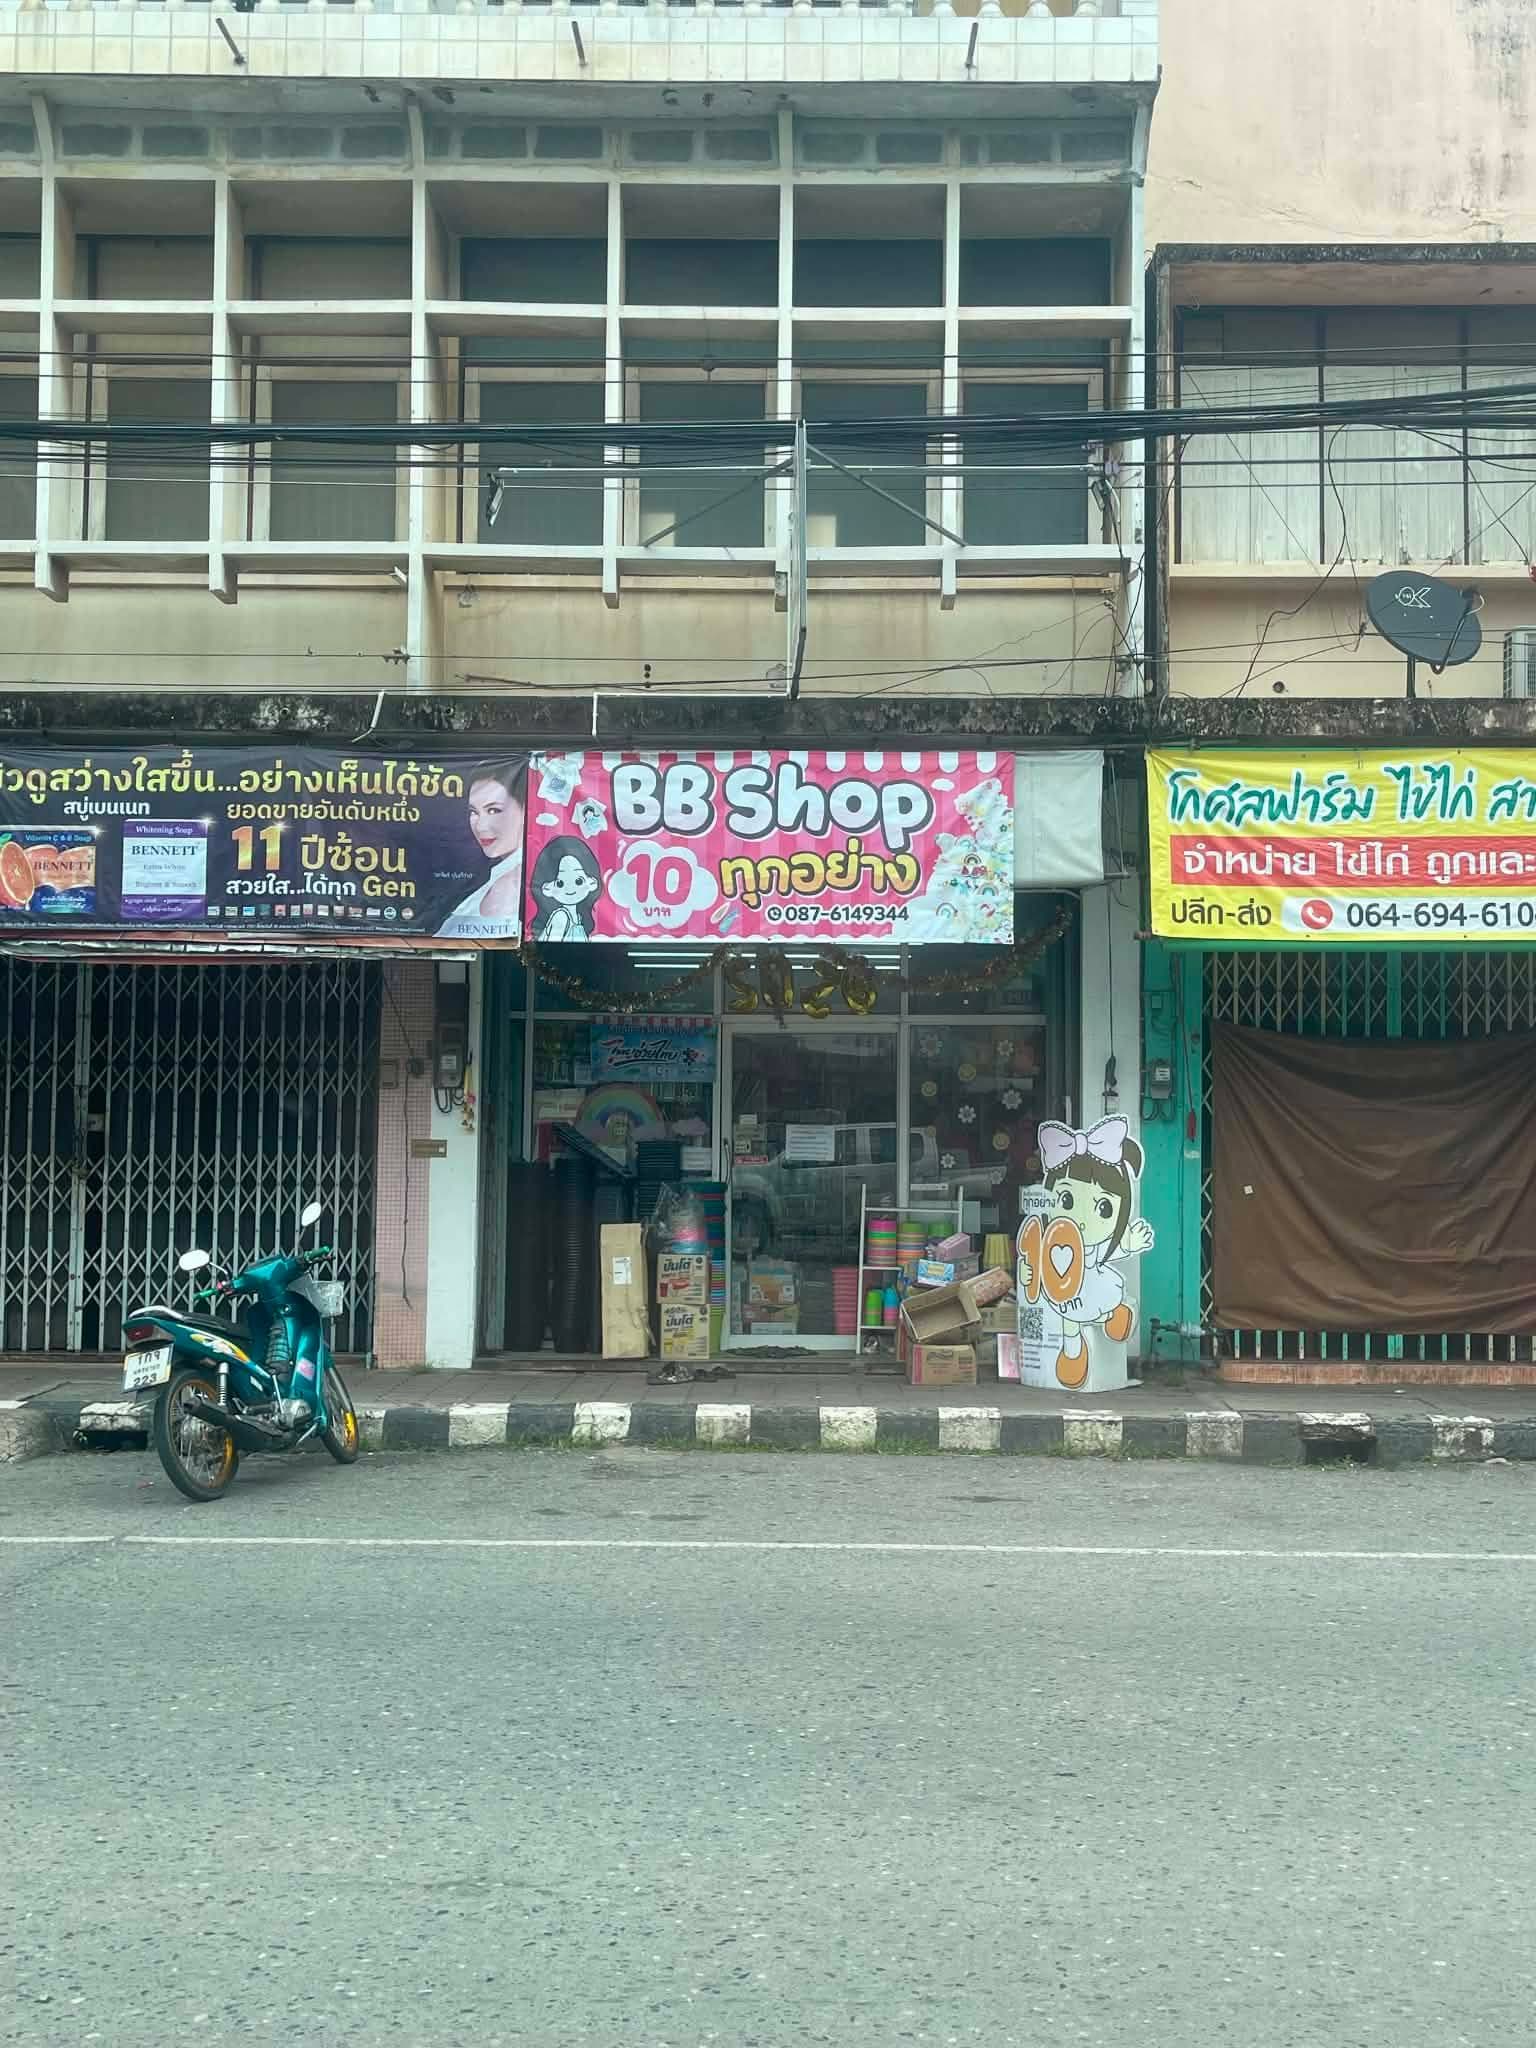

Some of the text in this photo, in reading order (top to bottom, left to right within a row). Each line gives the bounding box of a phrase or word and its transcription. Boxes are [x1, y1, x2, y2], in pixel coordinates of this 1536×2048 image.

[63, 796, 151, 821] สบู่เบนเนท
[610, 760, 934, 852] BB Shop
[1167, 768, 1374, 826] โกศลฟาร์ม
[1383, 764, 1474, 820] ไข่ไก่
[227, 796, 421, 823] ยอดขายอันดับหนึ่ง
[131, 845, 198, 856] BENNETT
[231, 826, 407, 873] 11 ปีซ้อน
[1183, 843, 1316, 876] จำหน่าย
[1328, 841, 1409, 876] ไข่ไก่
[33, 860, 92, 871] BENNETT
[626, 852, 694, 907] 10
[718, 836, 921, 909] ทุกอย่าง
[226, 871, 356, 900] สวยใส...ได้ทุก
[362, 875, 416, 898] Gen
[643, 906, 672, 918] บาท
[785, 905, 910, 923] 087-6149344
[1172, 896, 1536, 927] ปลีก-ส่ง 064-694-610
[457, 923, 511, 935] BENNETT
[1019, 1215, 1084, 1304] 10
[1058, 1296, 1083, 1314] บาท
[133, 1372, 157, 1388] 223
